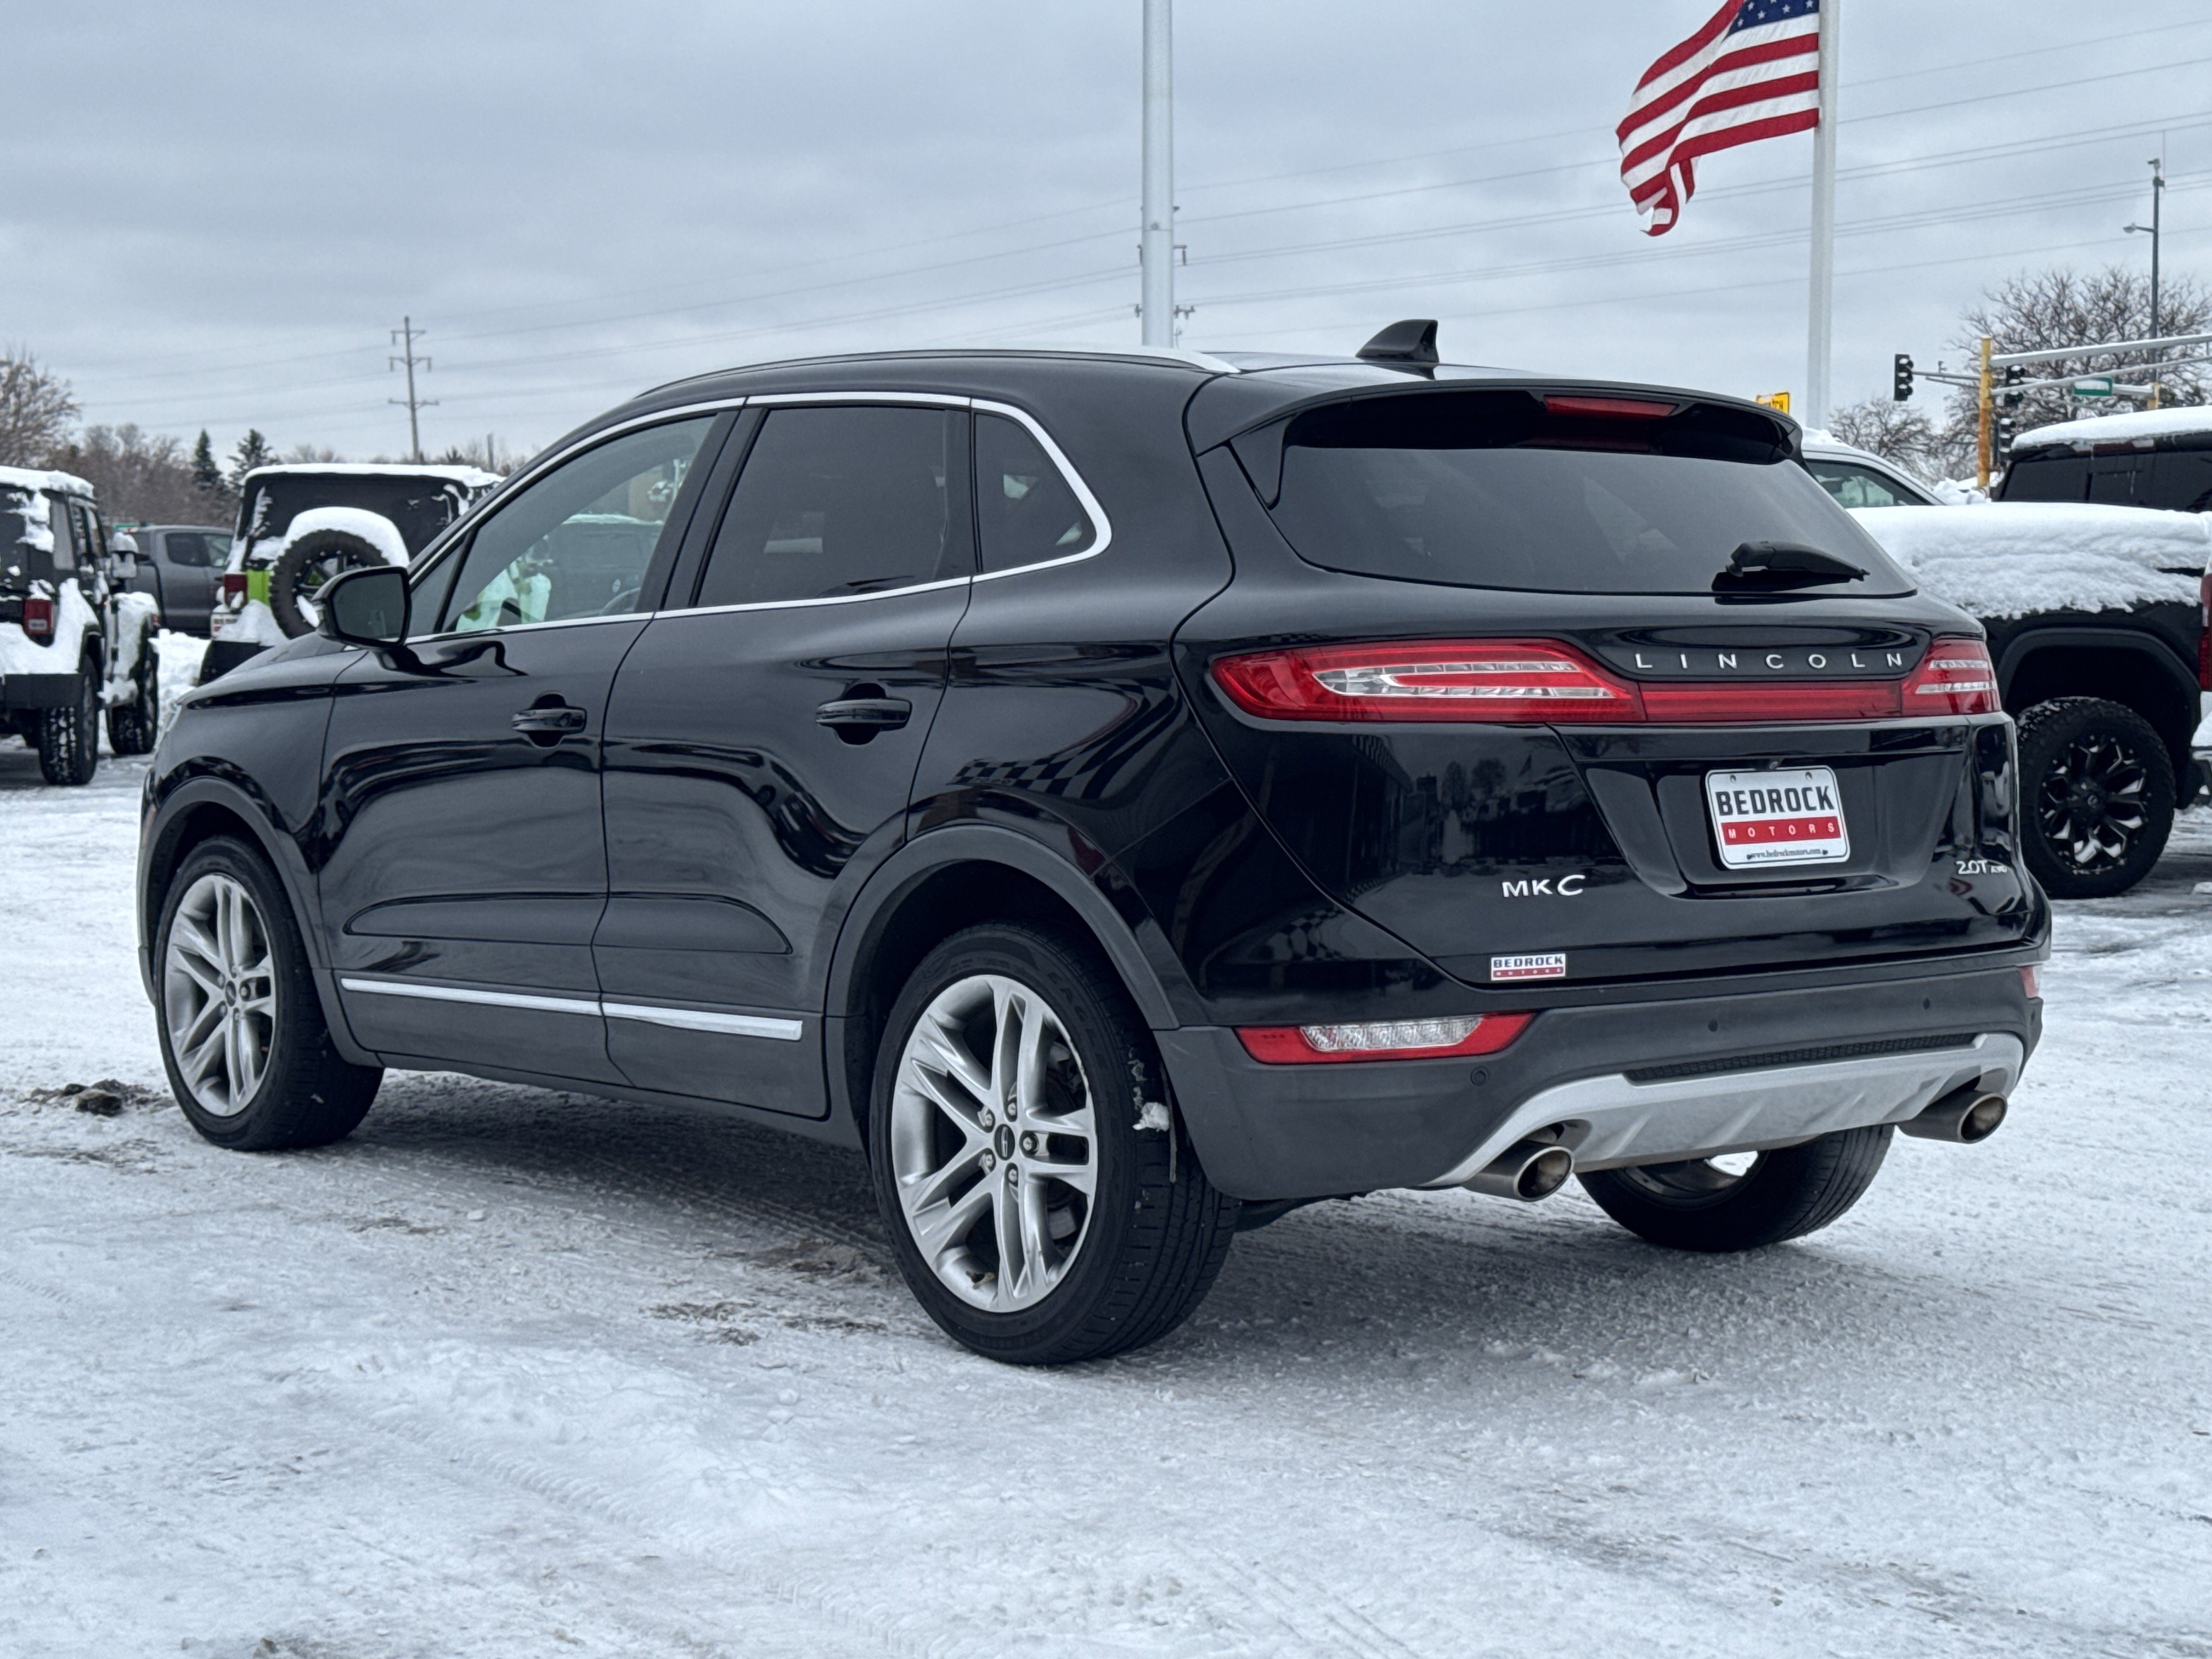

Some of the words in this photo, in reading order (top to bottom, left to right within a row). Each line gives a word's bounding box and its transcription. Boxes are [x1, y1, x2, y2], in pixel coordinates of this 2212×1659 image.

[1635, 652, 1903, 669] LINCOLN
[1715, 786, 1835, 816] BEDROCK
[1728, 822, 1835, 839] MOTORS
[1502, 874, 1586, 898] MKC
[1493, 956, 1563, 968] BEDROCK
